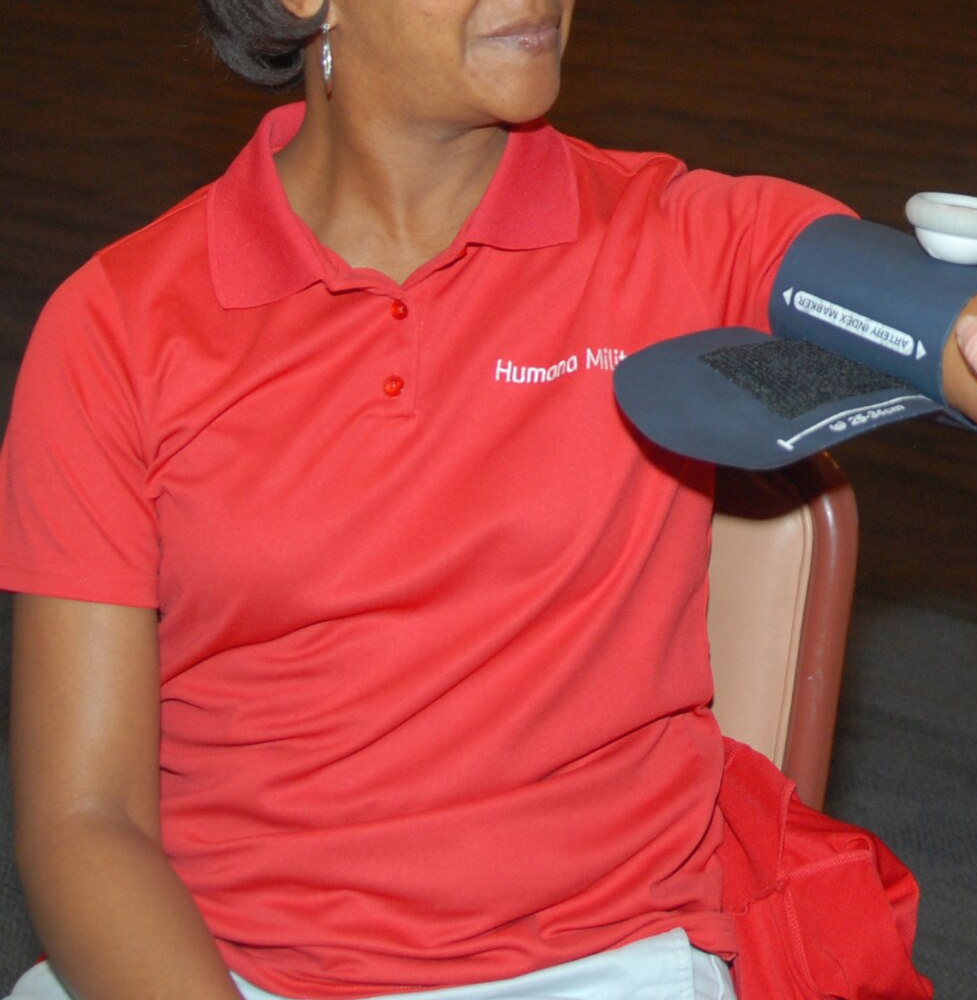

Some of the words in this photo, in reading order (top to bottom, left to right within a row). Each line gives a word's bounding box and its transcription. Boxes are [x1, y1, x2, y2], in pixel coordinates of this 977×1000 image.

[798, 296, 838, 320] MARKER
[839, 315, 870, 333] INDEX
[872, 327, 909, 349] ARTERY
[495, 358, 578, 384] Humana
